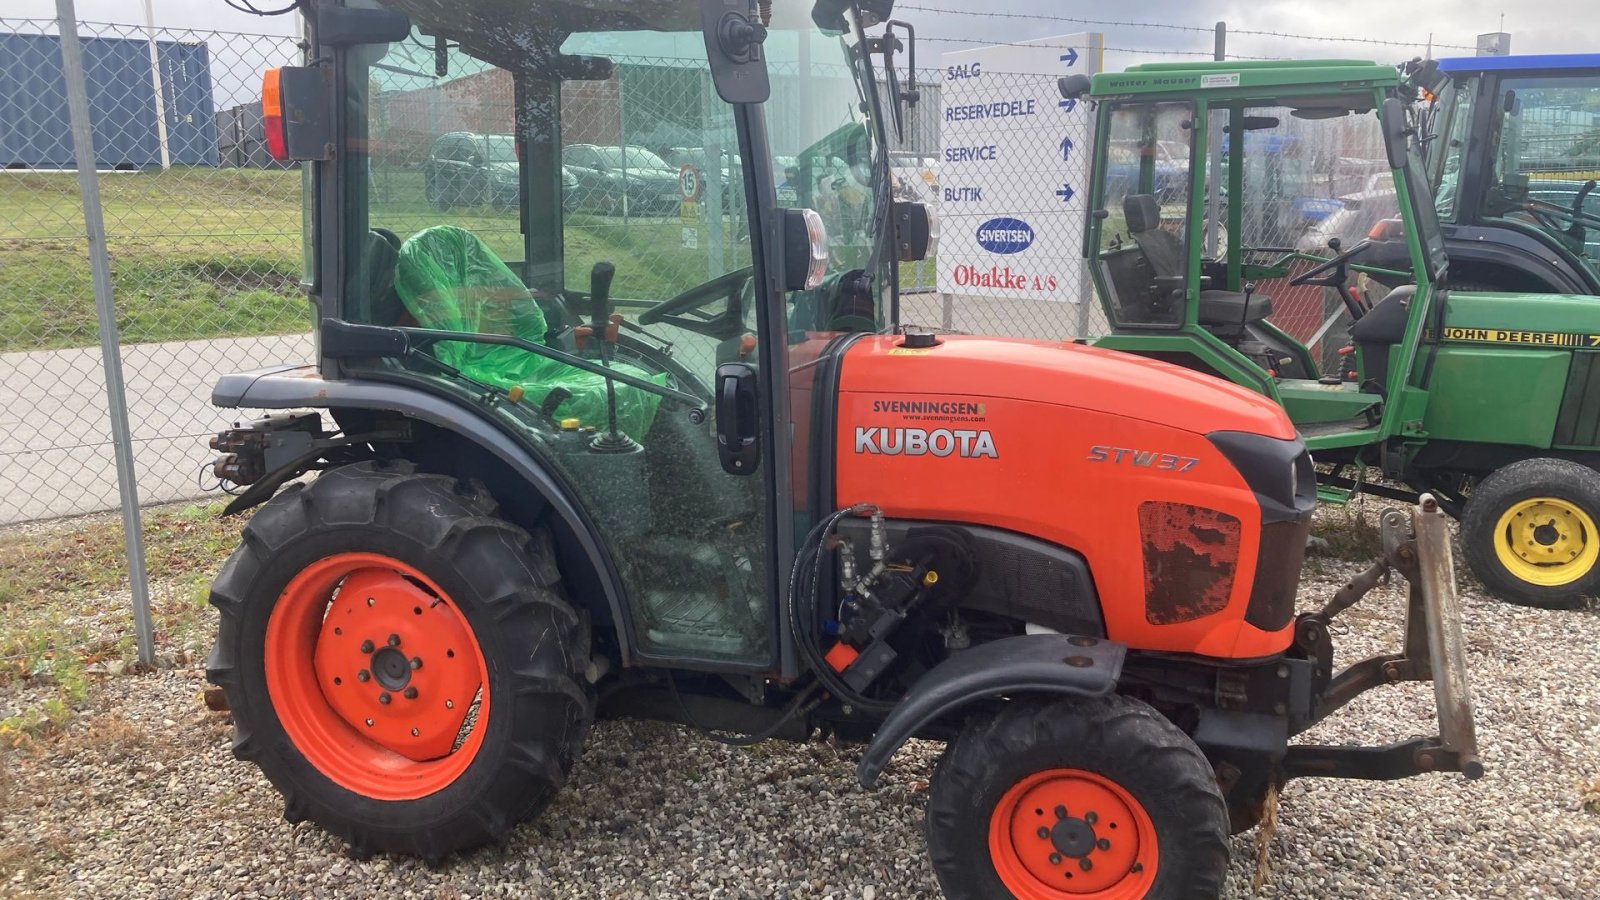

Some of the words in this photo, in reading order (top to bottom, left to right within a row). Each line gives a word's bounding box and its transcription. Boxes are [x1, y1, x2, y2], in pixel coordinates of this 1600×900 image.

[947, 62, 981, 81] SALG
[1153, 77, 1197, 86] Mauser
[945, 99, 1036, 122] RESERVEDELE
[945, 145, 997, 162] SERVICE
[683, 172, 695, 193] 15
[944, 187, 982, 202] BUTIK
[979, 229, 1031, 243] SIVERTSEN
[1031, 275, 1057, 292] A/S
[1444, 328, 1488, 340] JOHN
[1496, 331, 1555, 344] DEERE
[902, 413, 986, 423] www.svenningsens.com
[855, 426, 999, 459] KUBOTA
[1087, 445, 1200, 474] STW37
